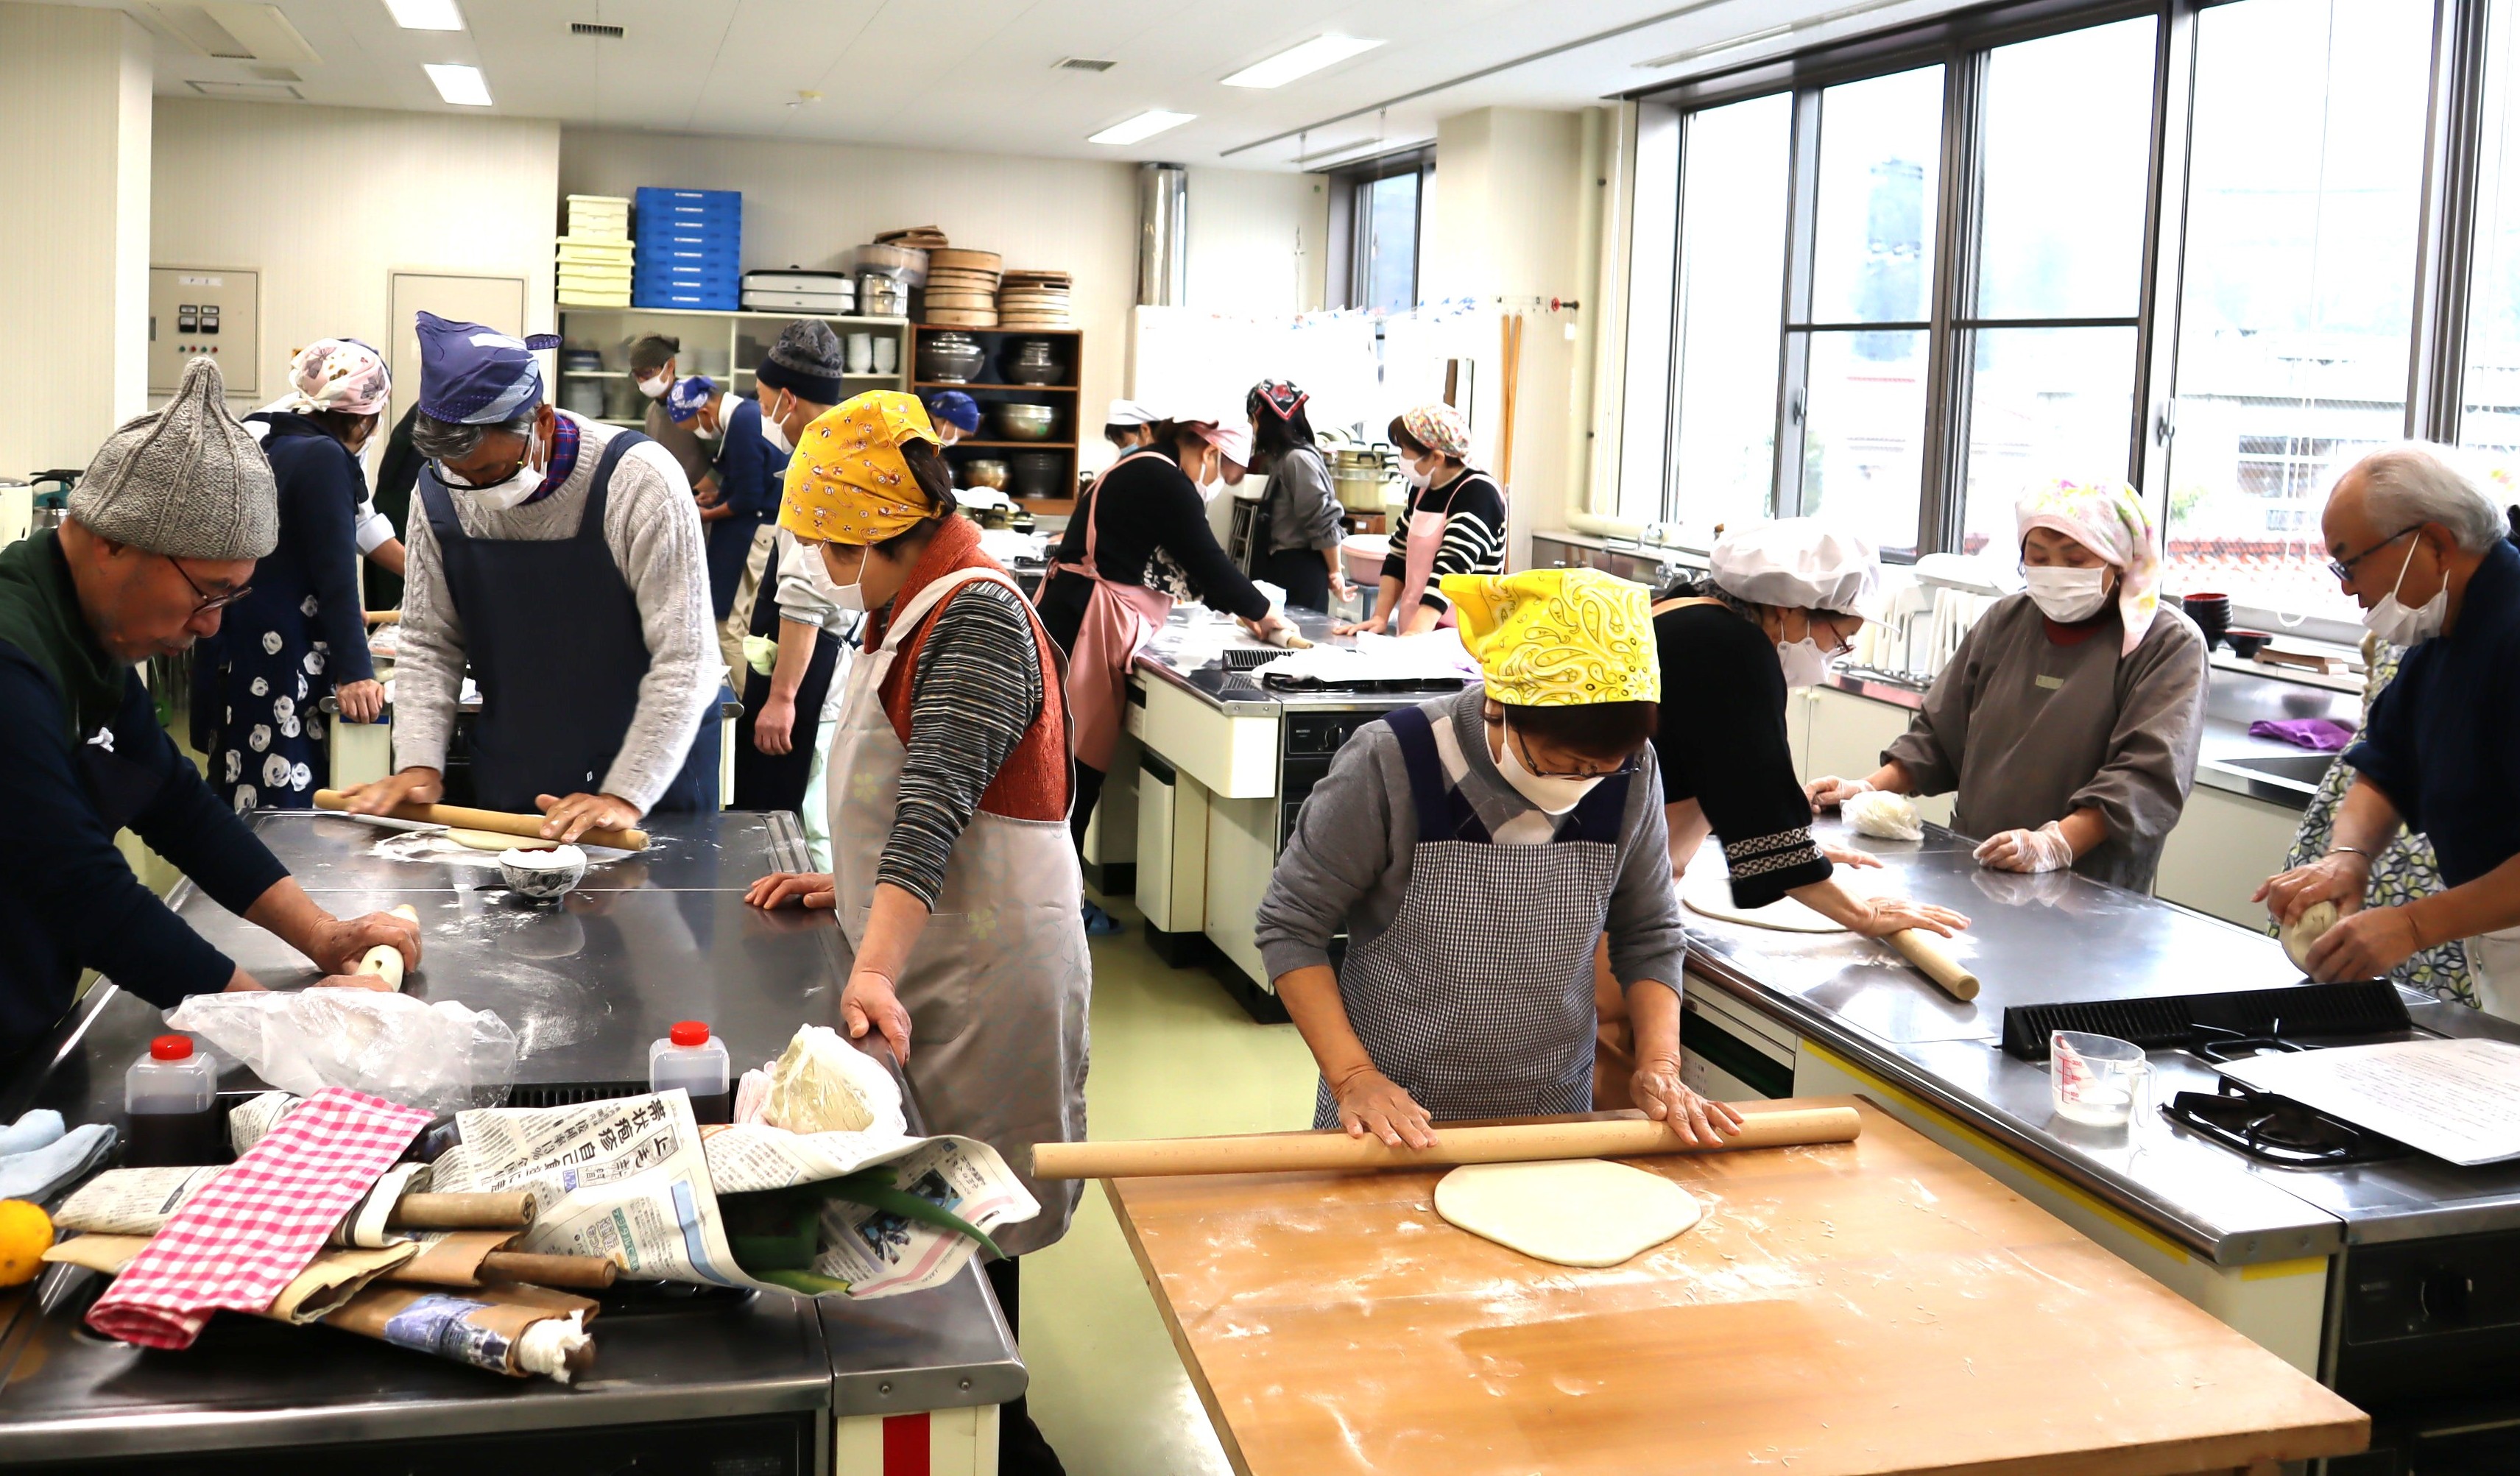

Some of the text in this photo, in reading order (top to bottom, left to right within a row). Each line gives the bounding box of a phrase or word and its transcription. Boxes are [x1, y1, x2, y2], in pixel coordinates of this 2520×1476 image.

[532, 1119, 589, 1160] 接種率13%
[599, 1098, 666, 1151] 帯状疱疹
[586, 1137, 668, 1181] 上毛新聞
[587, 1225, 607, 1259] もっと
[596, 1216, 619, 1254] 運転
